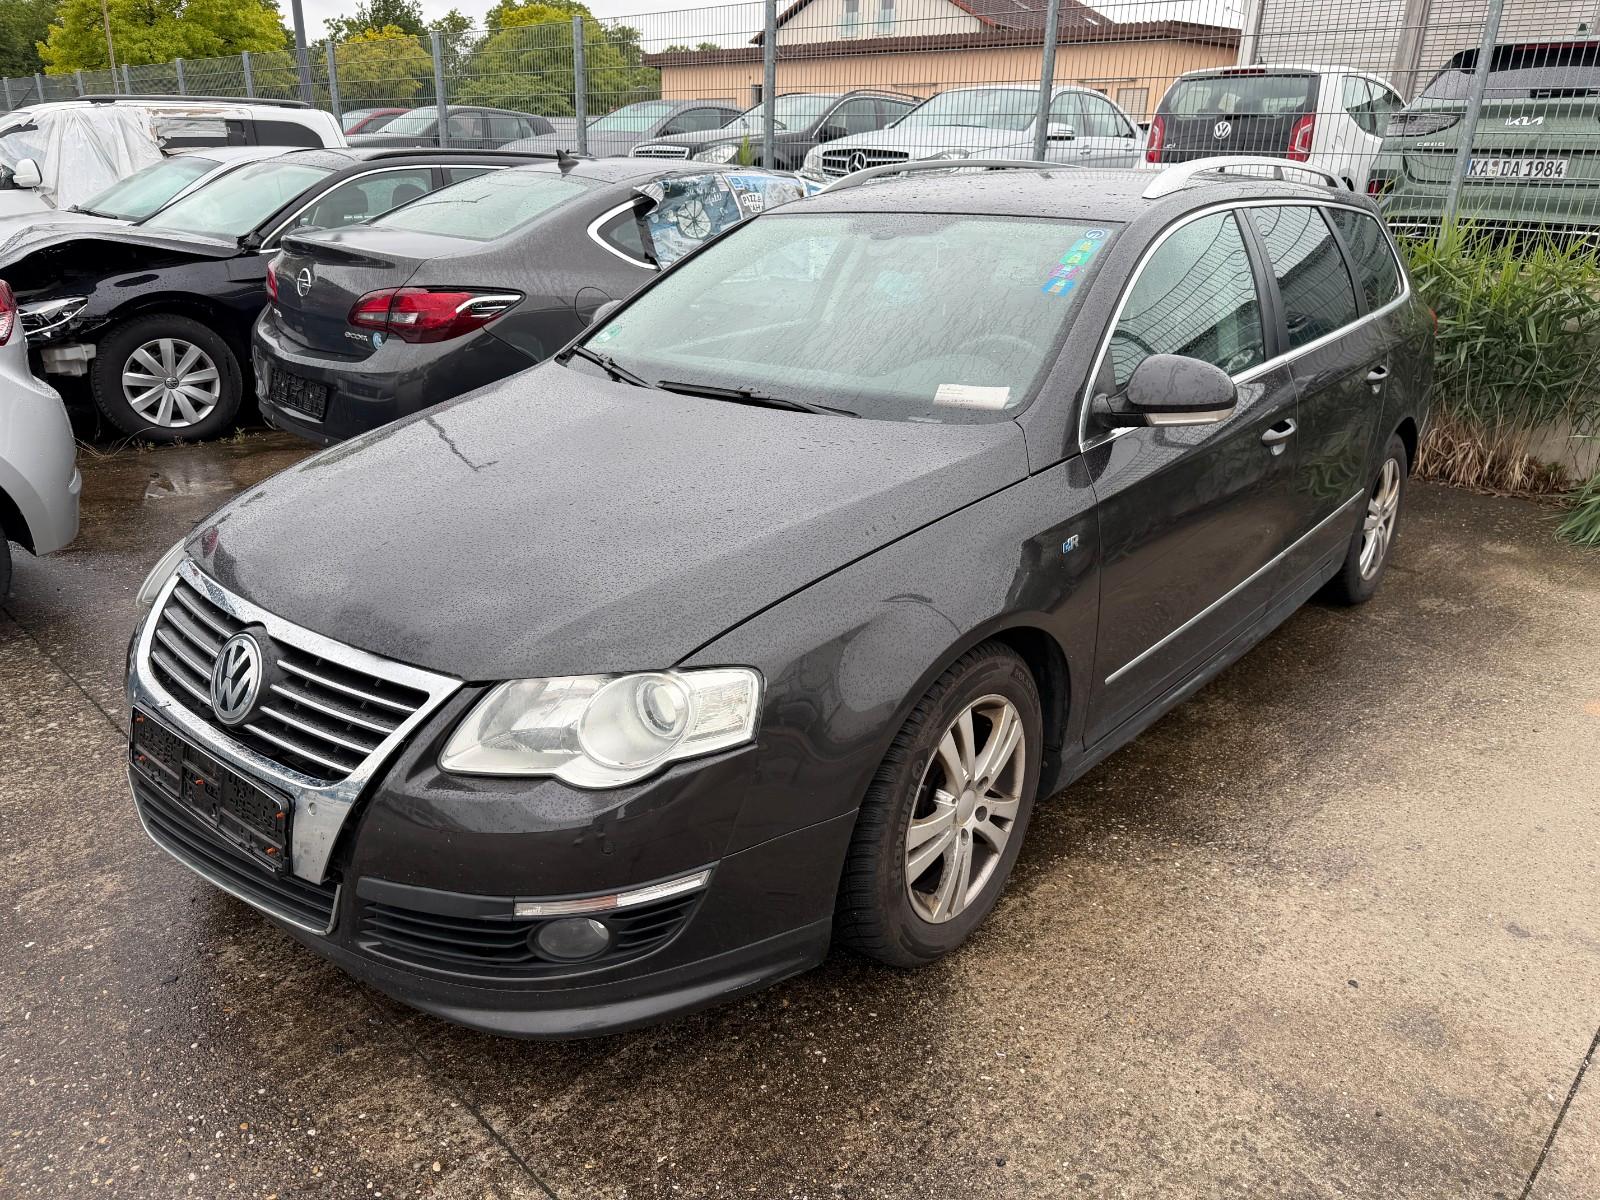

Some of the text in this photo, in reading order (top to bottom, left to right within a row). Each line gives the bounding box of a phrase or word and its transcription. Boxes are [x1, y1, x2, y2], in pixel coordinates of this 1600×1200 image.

[1469, 160, 1564, 177] KA DA 1984
[212, 632, 262, 724] VW
